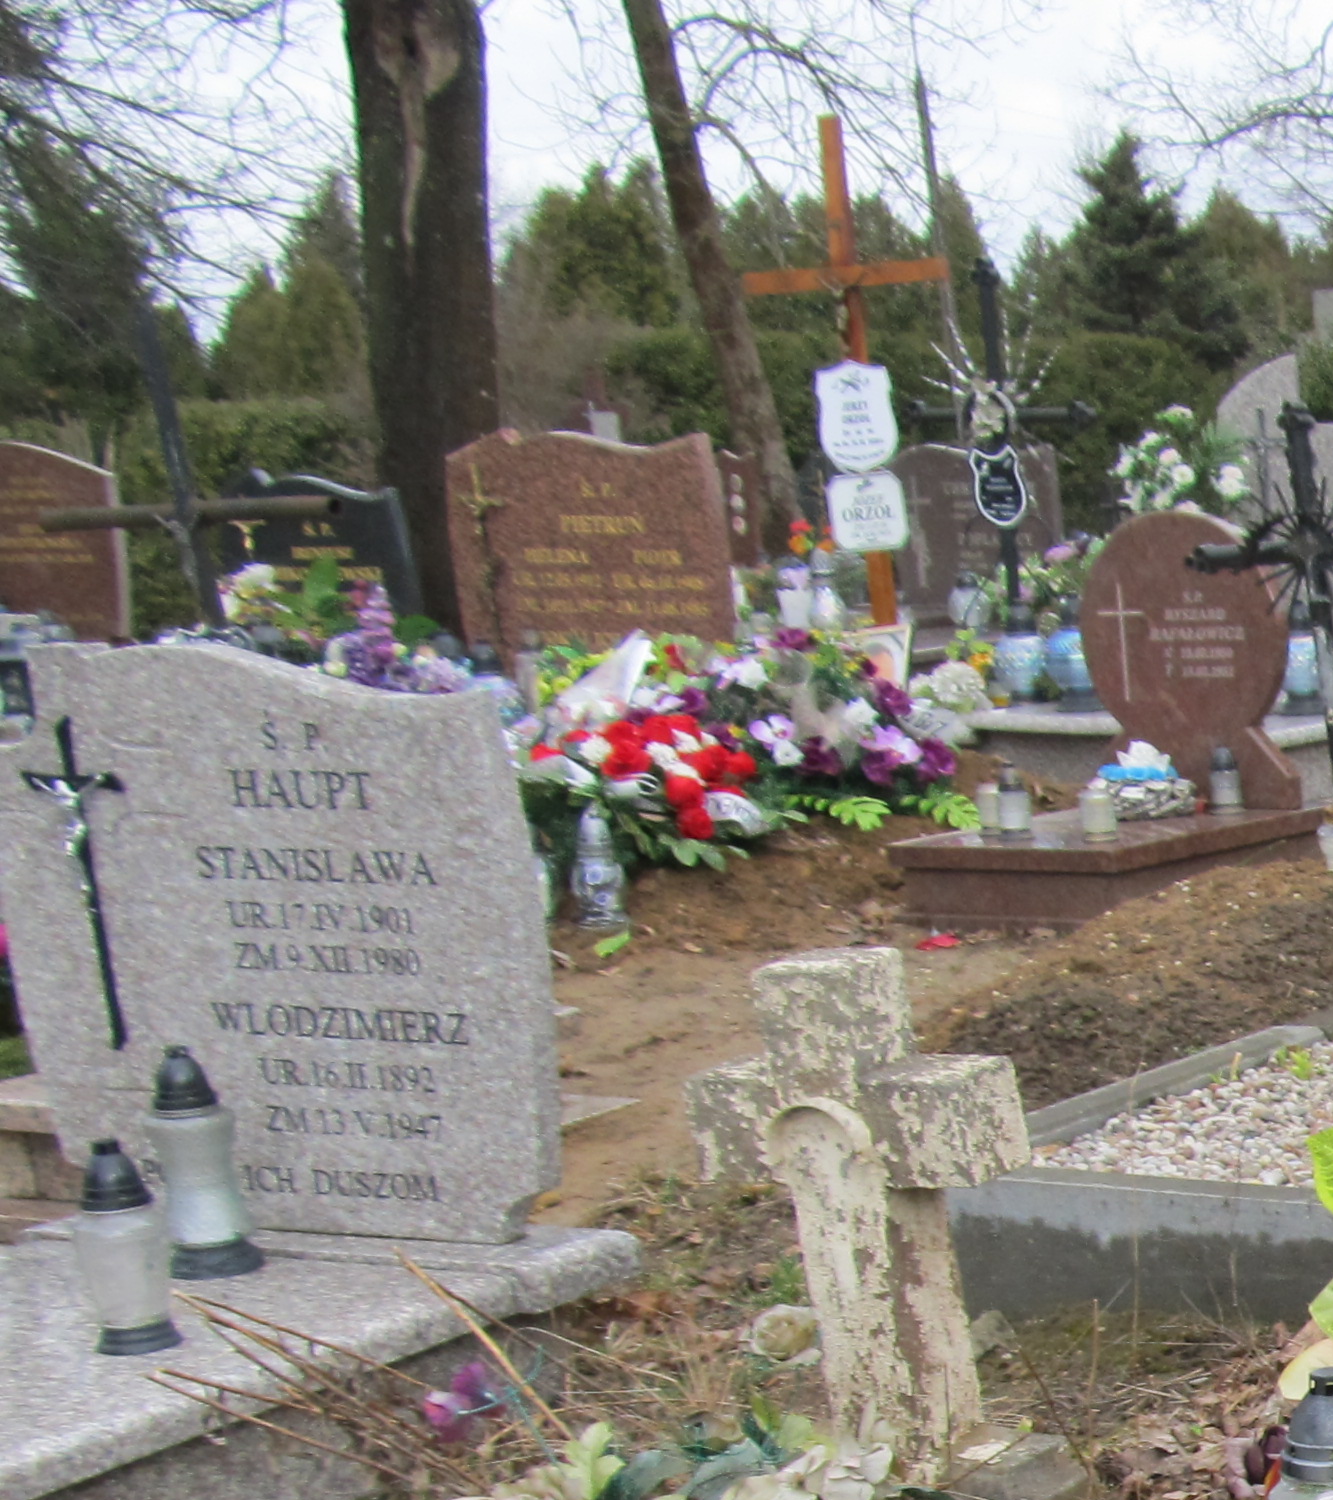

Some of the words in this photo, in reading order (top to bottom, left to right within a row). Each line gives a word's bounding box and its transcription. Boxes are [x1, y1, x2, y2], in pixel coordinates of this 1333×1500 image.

[228, 768, 370, 810] HAUPT
[240, 1164, 299, 1194] ICH
[311, 1168, 442, 1202] DUSZOM
